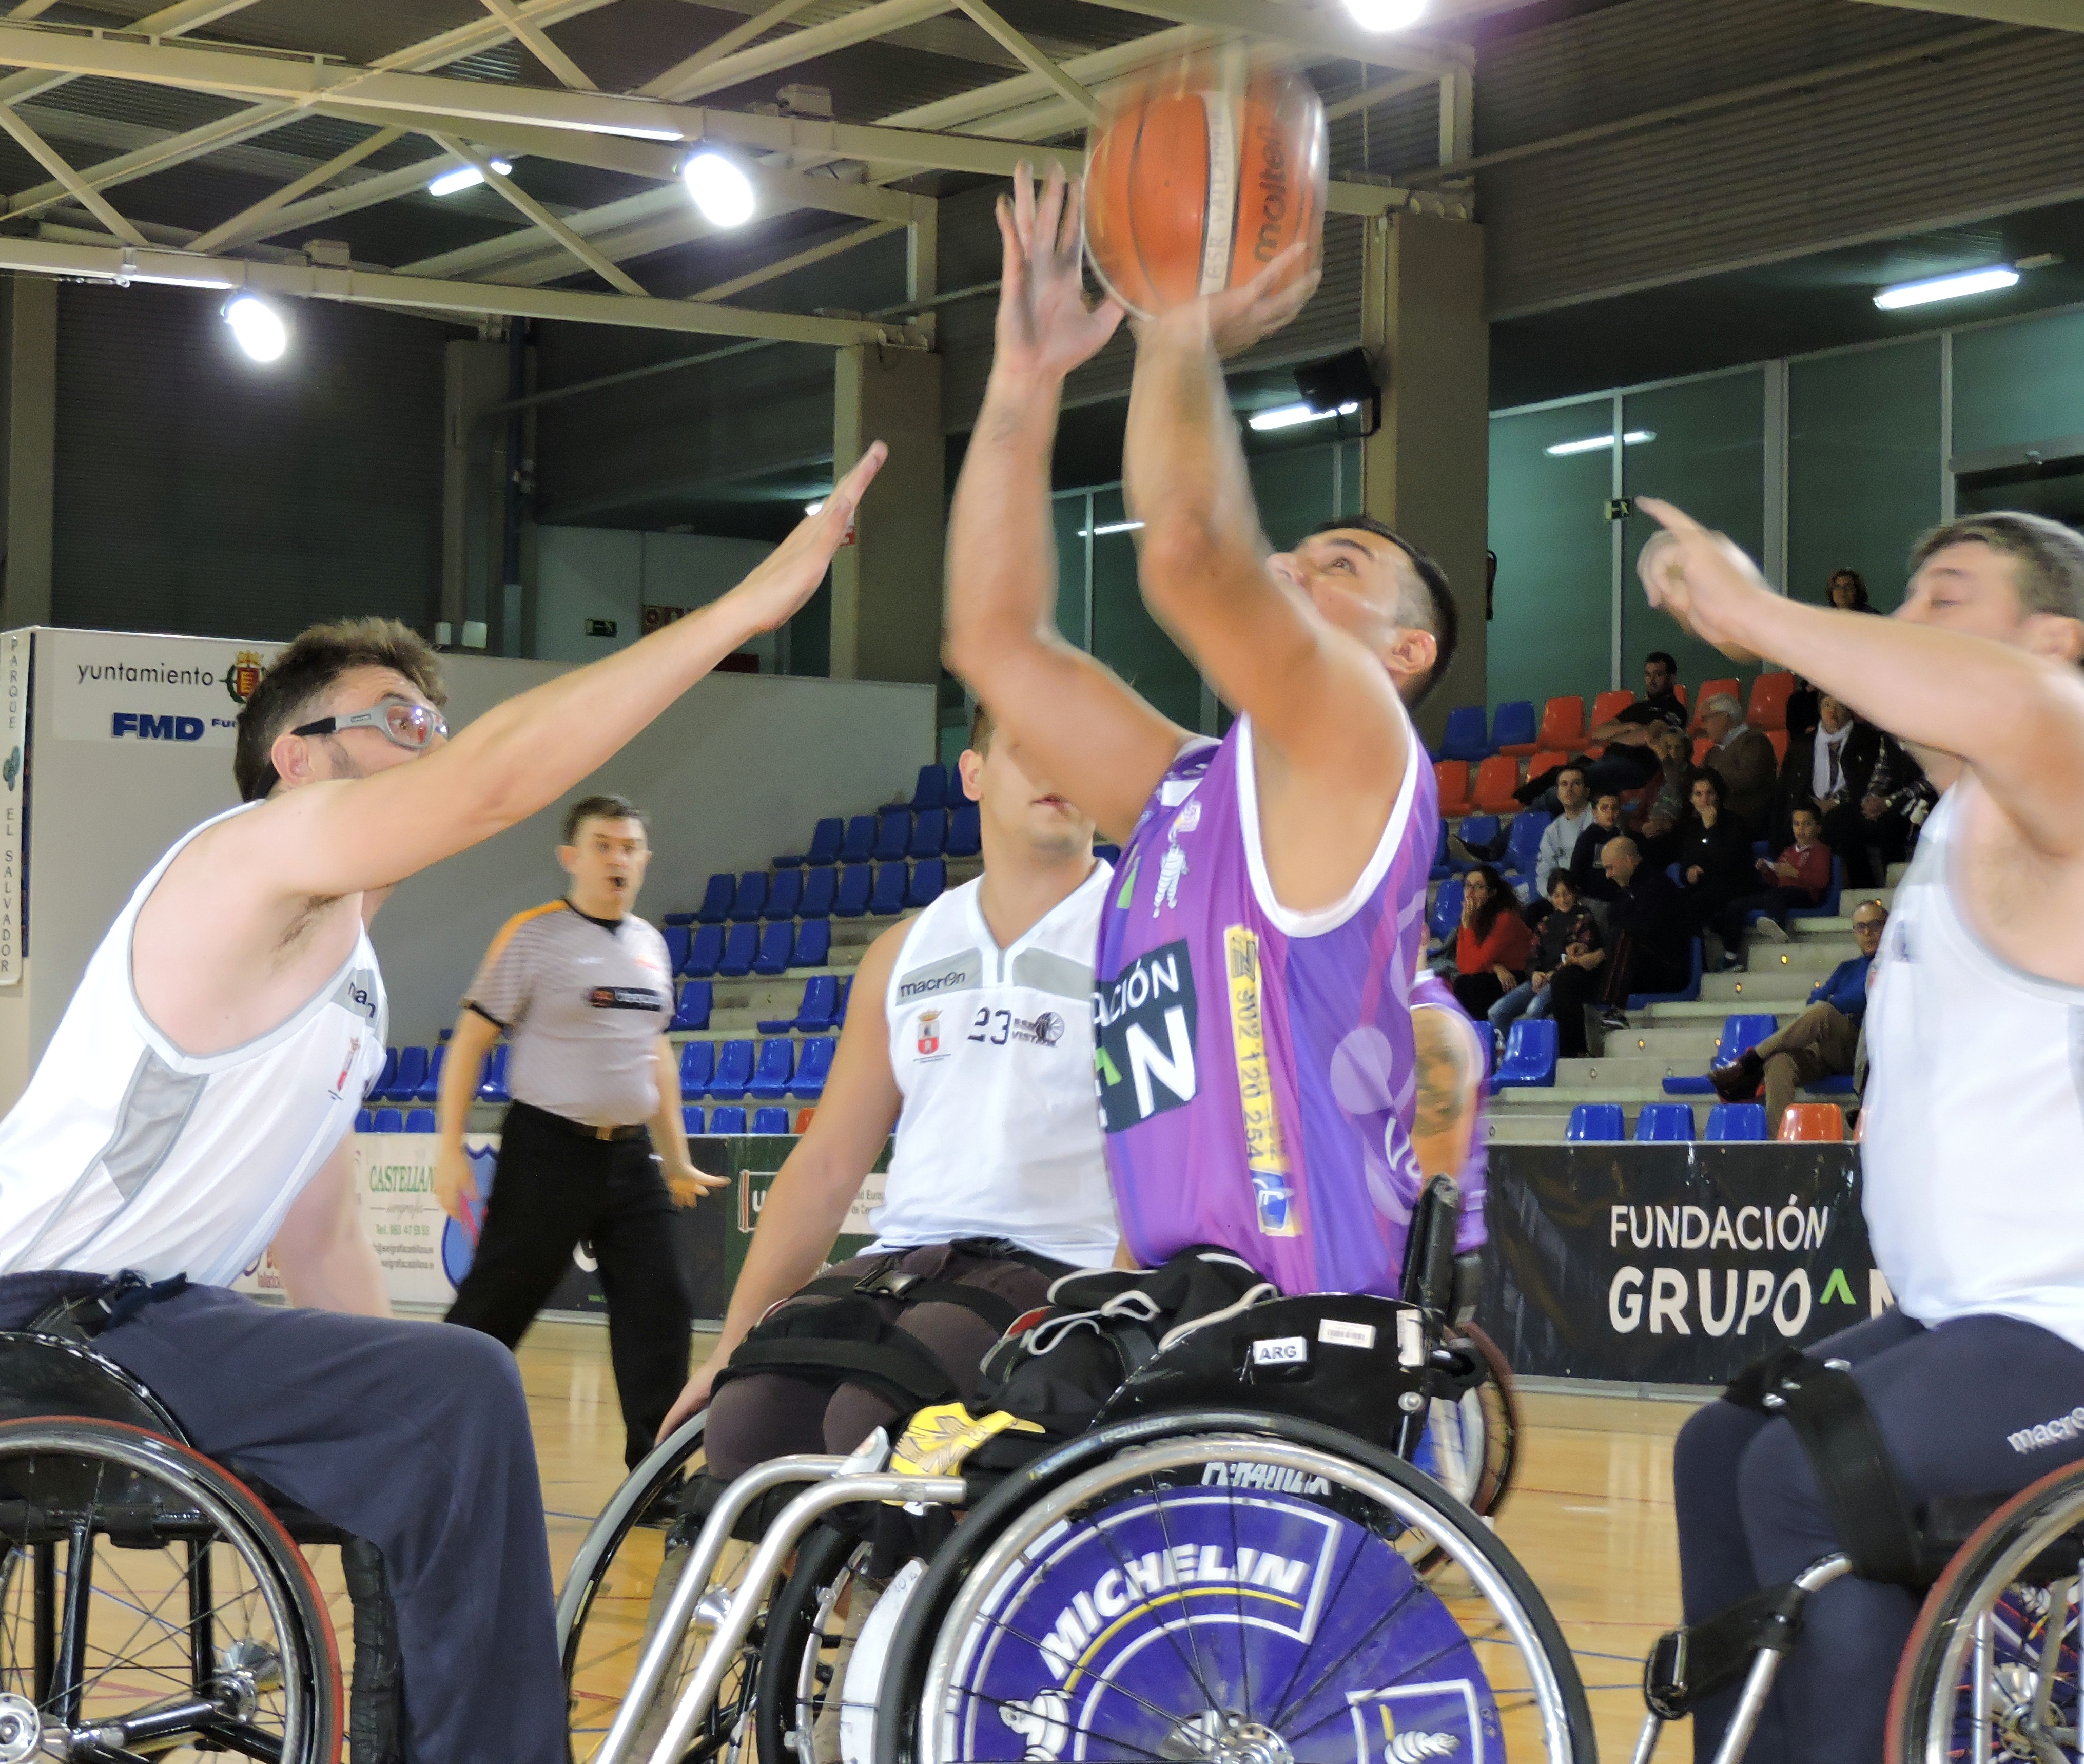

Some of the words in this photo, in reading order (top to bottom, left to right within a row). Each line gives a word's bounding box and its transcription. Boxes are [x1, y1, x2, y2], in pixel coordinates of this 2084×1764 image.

[9, 639, 18, 728] PARQUE
[111, 712, 205, 741] FMD
[6, 808, 14, 836] EL
[1, 850, 13, 972] SALVADOR
[901, 972, 966, 997] macron
[968, 1006, 1011, 1045] 23
[1610, 1194, 1828, 1250] FUNDACIÓN
[1609, 1266, 1812, 1337] GRUPO
[1259, 1345, 1297, 1360] ARG
[1039, 1543, 1310, 1680] MICHELIN
